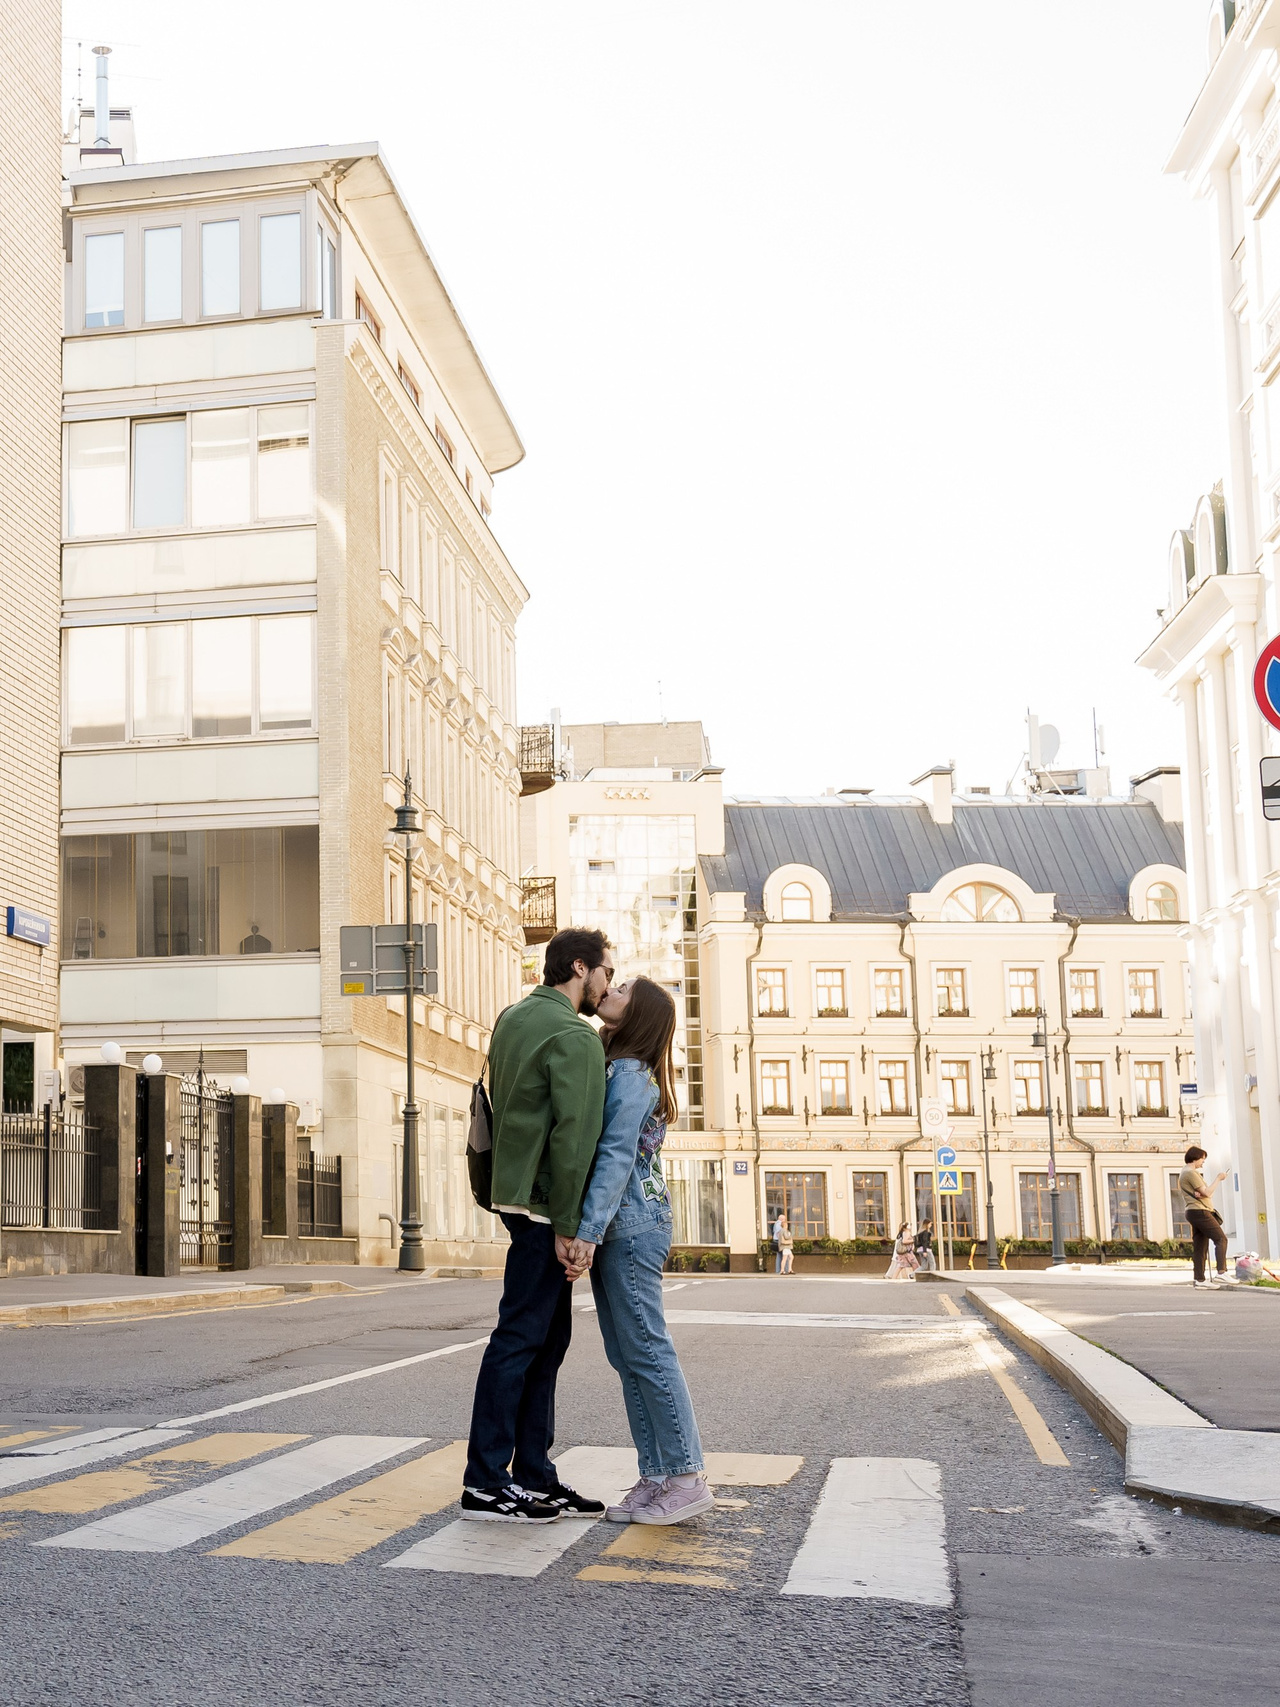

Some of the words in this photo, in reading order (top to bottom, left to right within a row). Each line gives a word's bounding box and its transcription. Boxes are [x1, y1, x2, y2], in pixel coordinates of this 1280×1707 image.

[929, 1113, 939, 1121] 50
[684, 1141, 717, 1149] HOTEL
[735, 1163, 747, 1171] 32
